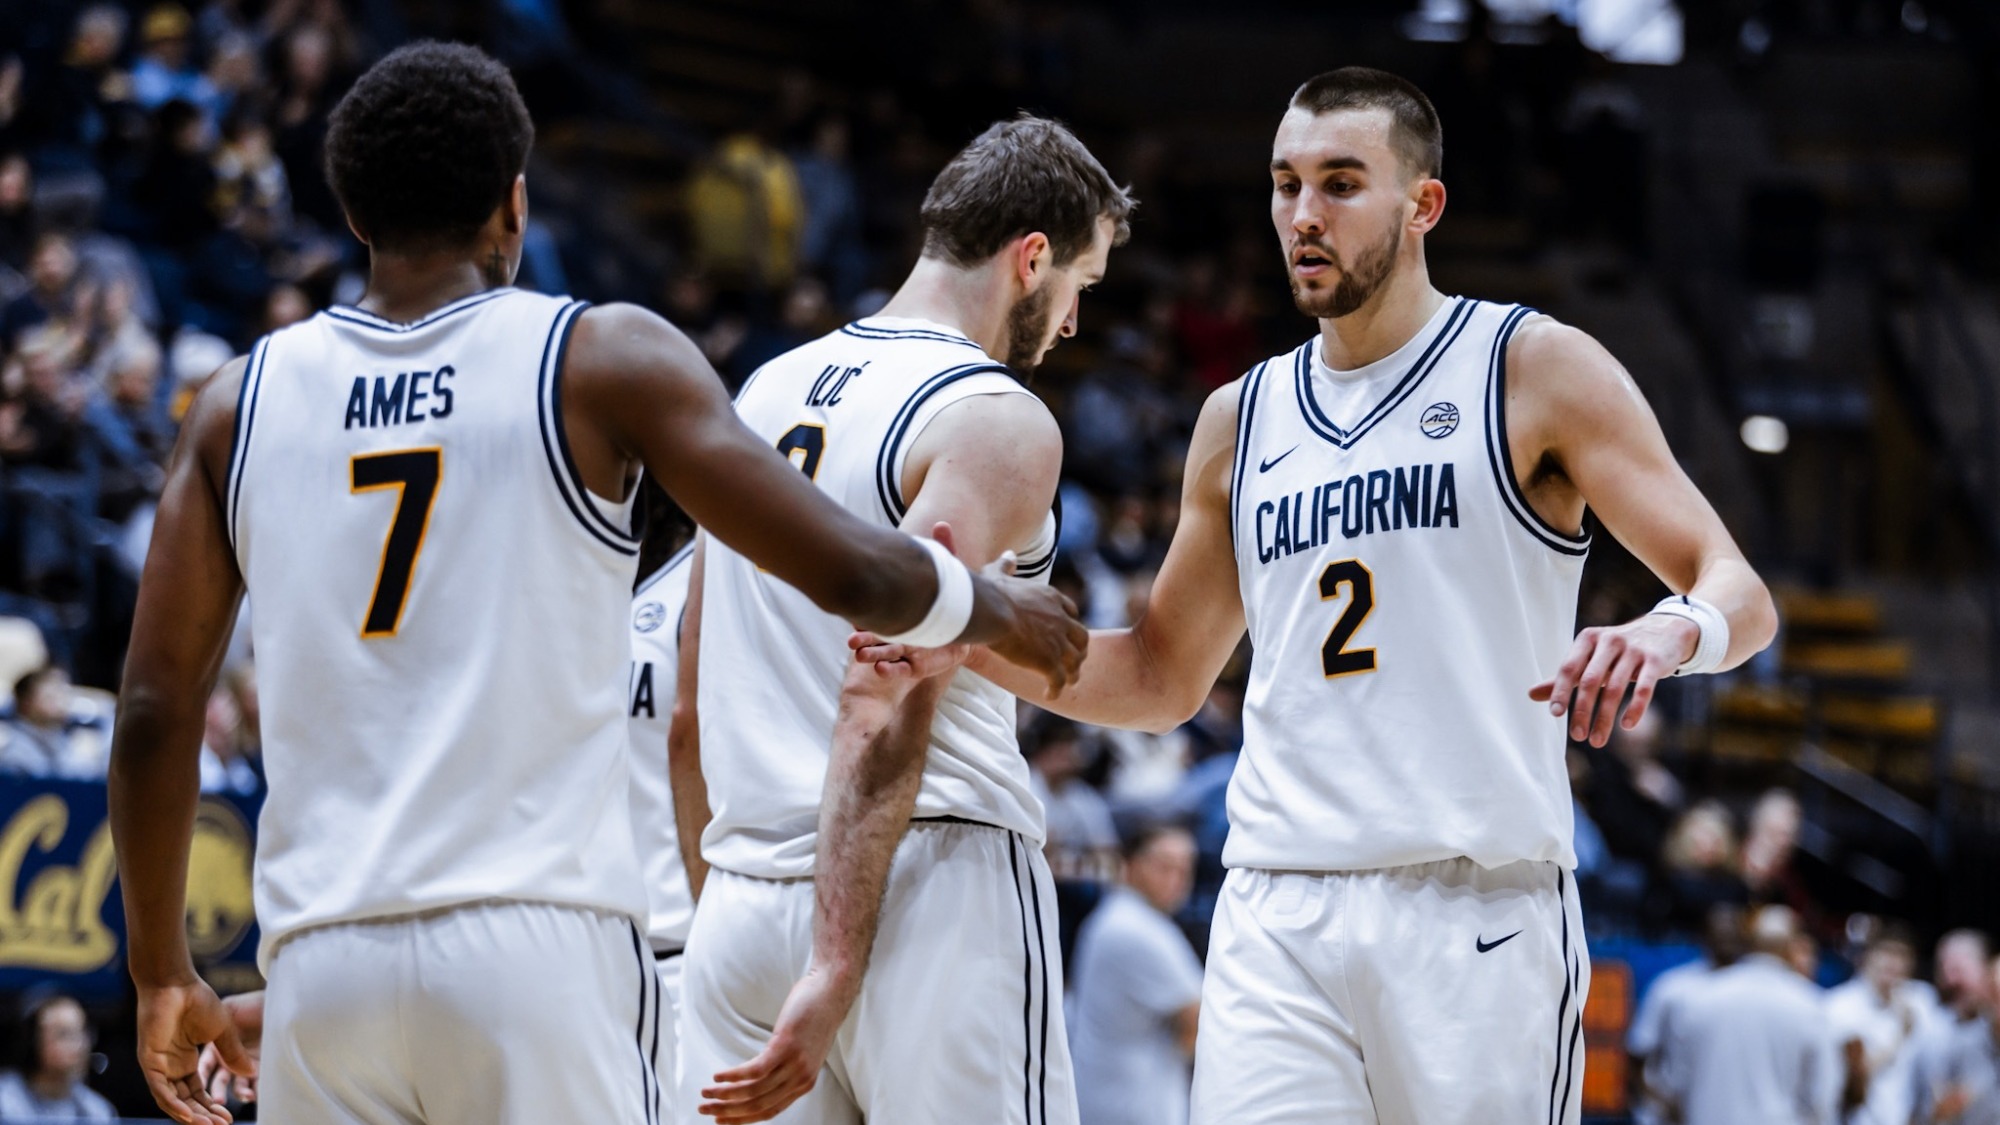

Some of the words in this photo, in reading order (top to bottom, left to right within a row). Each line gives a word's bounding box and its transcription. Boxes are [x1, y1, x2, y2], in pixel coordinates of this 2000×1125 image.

[345, 366, 455, 430] AMES
[805, 361, 871, 407] ILIĆ
[1425, 413, 1458, 423] ACC
[350, 446, 443, 639] 7
[1256, 463, 1459, 564] CALIFORNIA
[1318, 558, 1377, 679] 2
[0, 794, 118, 972] Cal
